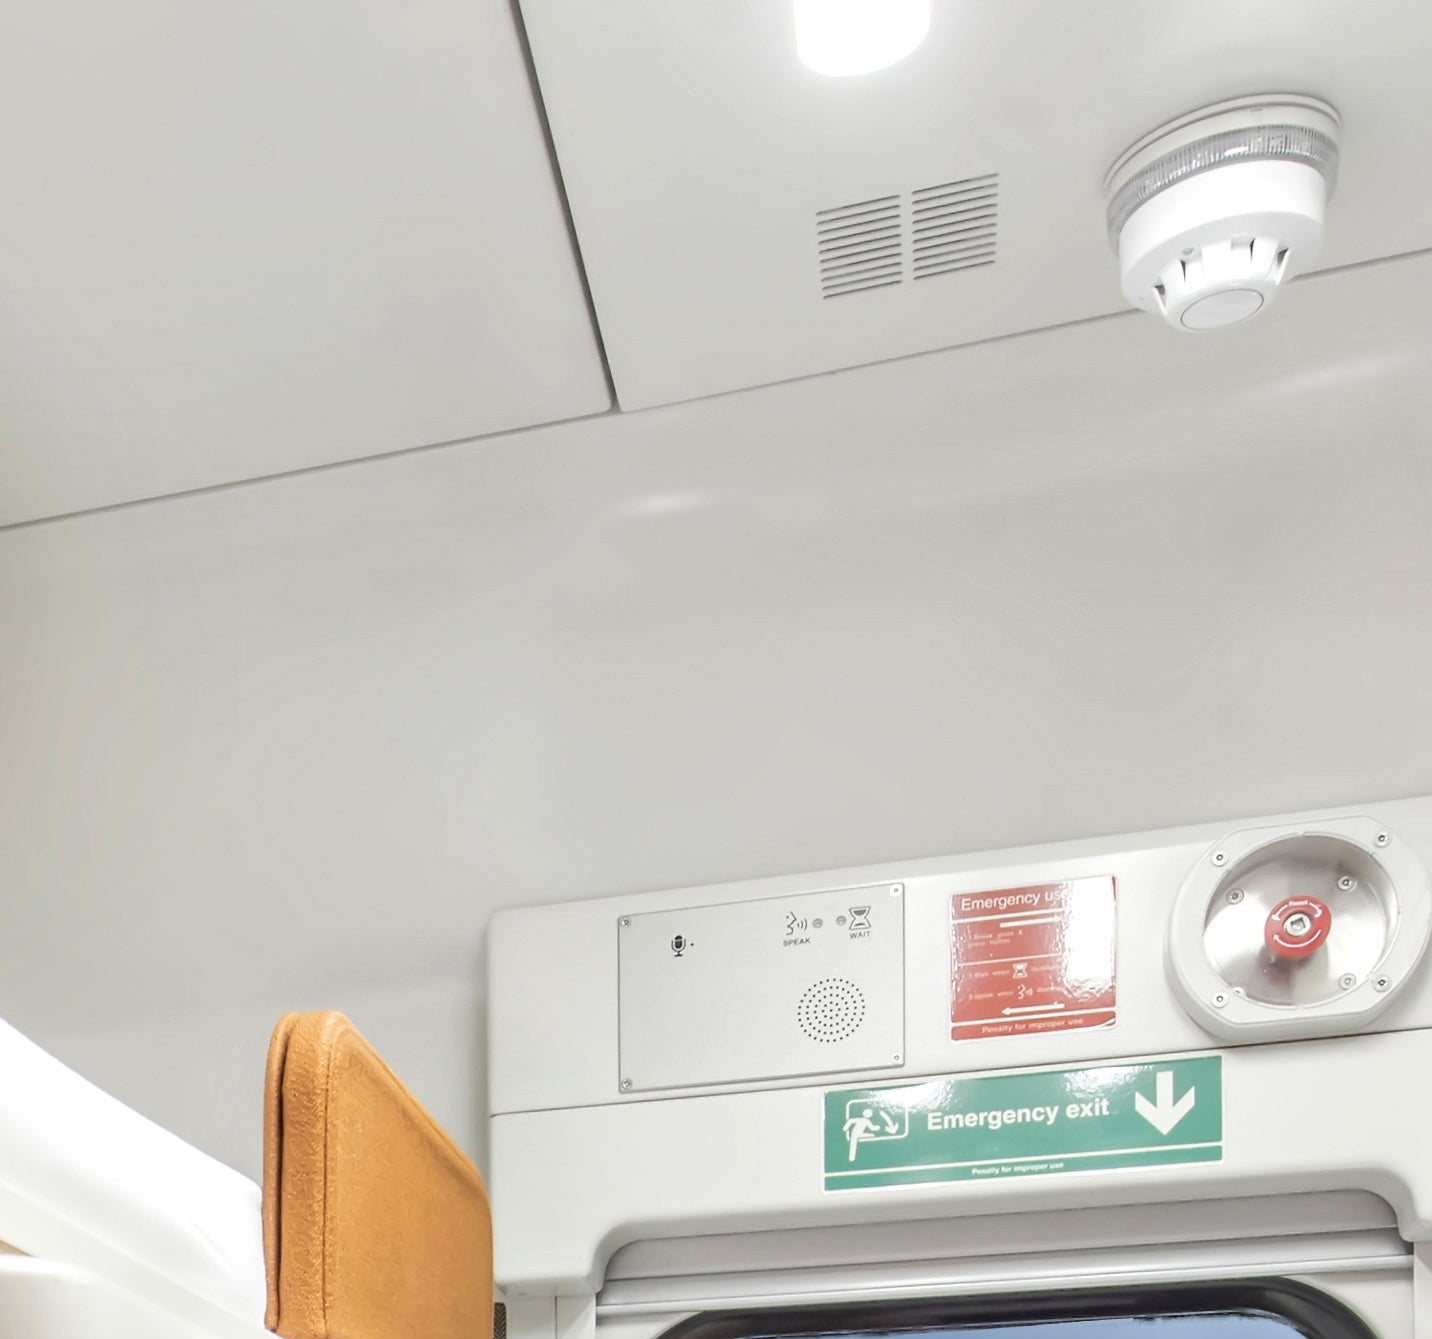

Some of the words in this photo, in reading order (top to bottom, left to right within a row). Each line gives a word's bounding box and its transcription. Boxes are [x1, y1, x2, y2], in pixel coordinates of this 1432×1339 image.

[960, 892, 1041, 912] Emergency
[849, 930, 871, 940] WAIT
[782, 937, 812, 947] SPEAK
[982, 1025, 1013, 1034] Penalty
[1028, 1020, 1066, 1030] improper
[927, 1104, 1060, 1131] Emergency
[1065, 1098, 1110, 1120] exit
[971, 1167, 1000, 1176] Penalty
[1001, 1166, 1012, 1174] for
[1014, 1163, 1048, 1173] improper
